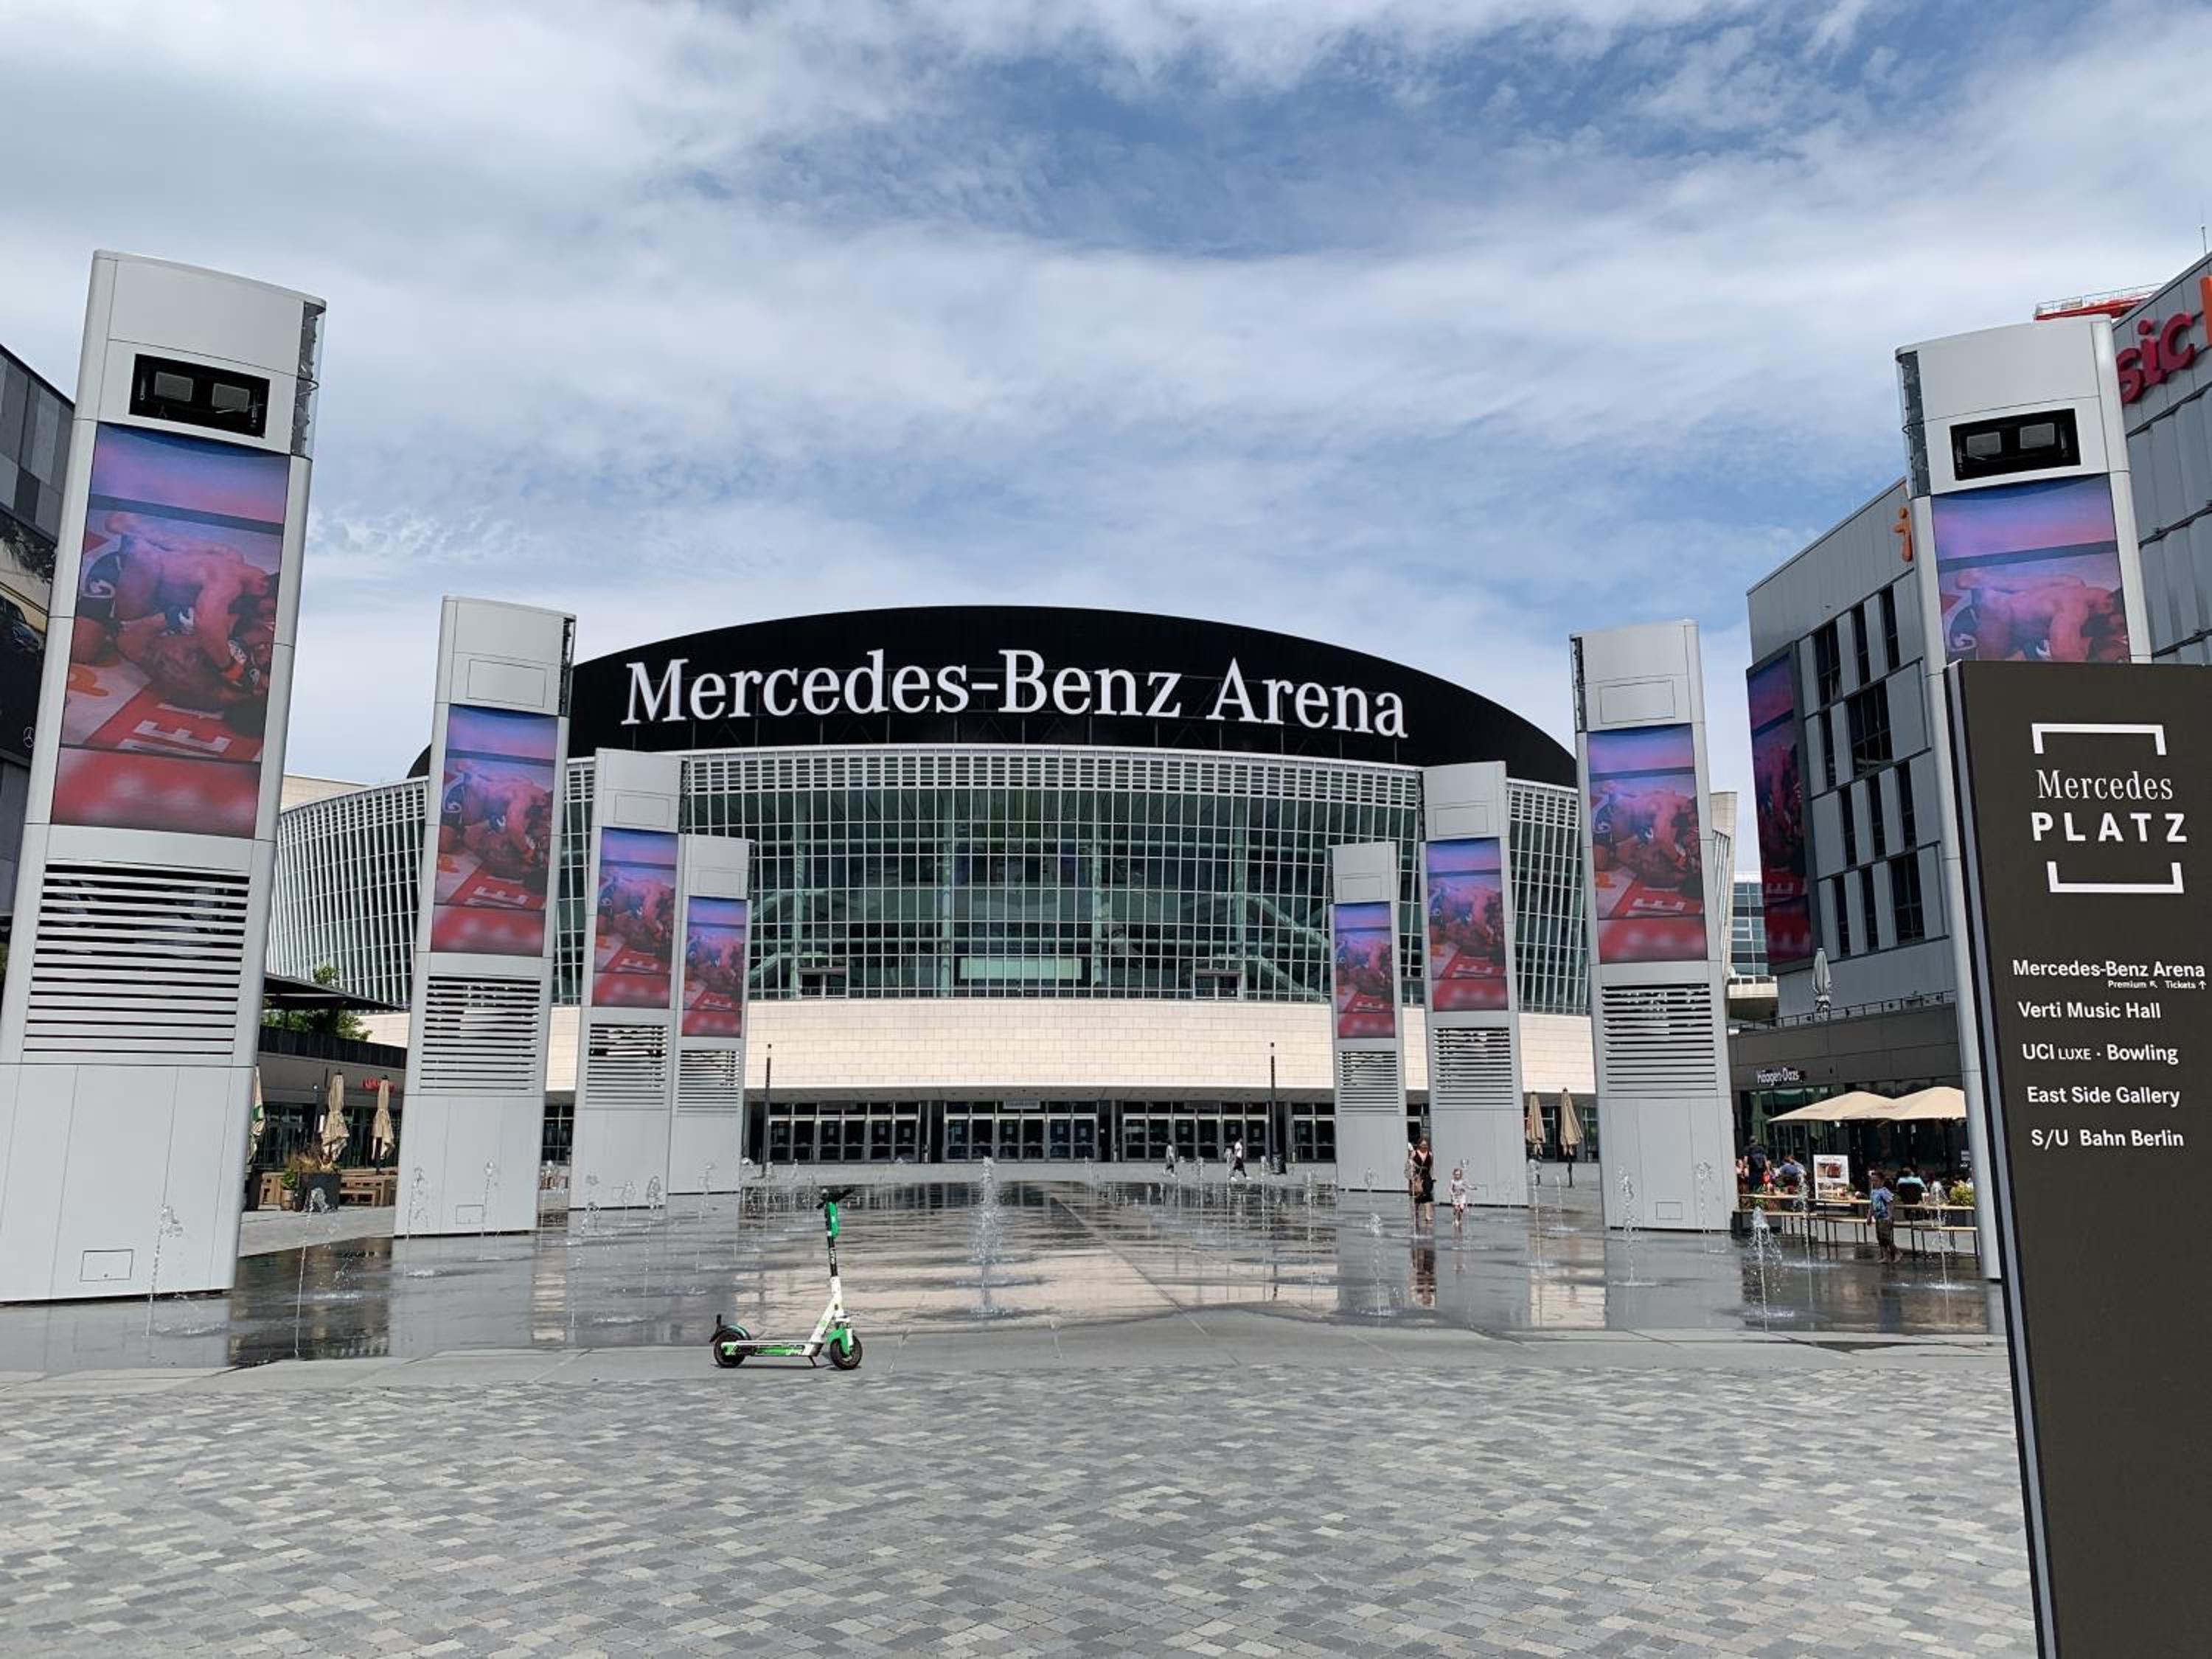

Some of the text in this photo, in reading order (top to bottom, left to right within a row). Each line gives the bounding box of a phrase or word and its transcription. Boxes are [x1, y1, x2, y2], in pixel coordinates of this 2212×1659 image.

[621, 649, 1408, 738] Mercedes-Benz Arena
[2035, 769, 2173, 800] Mercedes
[2031, 812, 2188, 843] PLATZ
[2012, 959, 2205, 978] Mercedes-Benz Arena
[2108, 980, 2197, 989] Premium Tickets
[2017, 1001, 2161, 1019] Verti Music Hall
[2022, 1043, 2179, 1065] UCI LUXE Bowling
[2027, 1086, 2180, 1108] East Side Gallery
[2031, 1129, 2184, 1150] S/U Bahn Berlin
